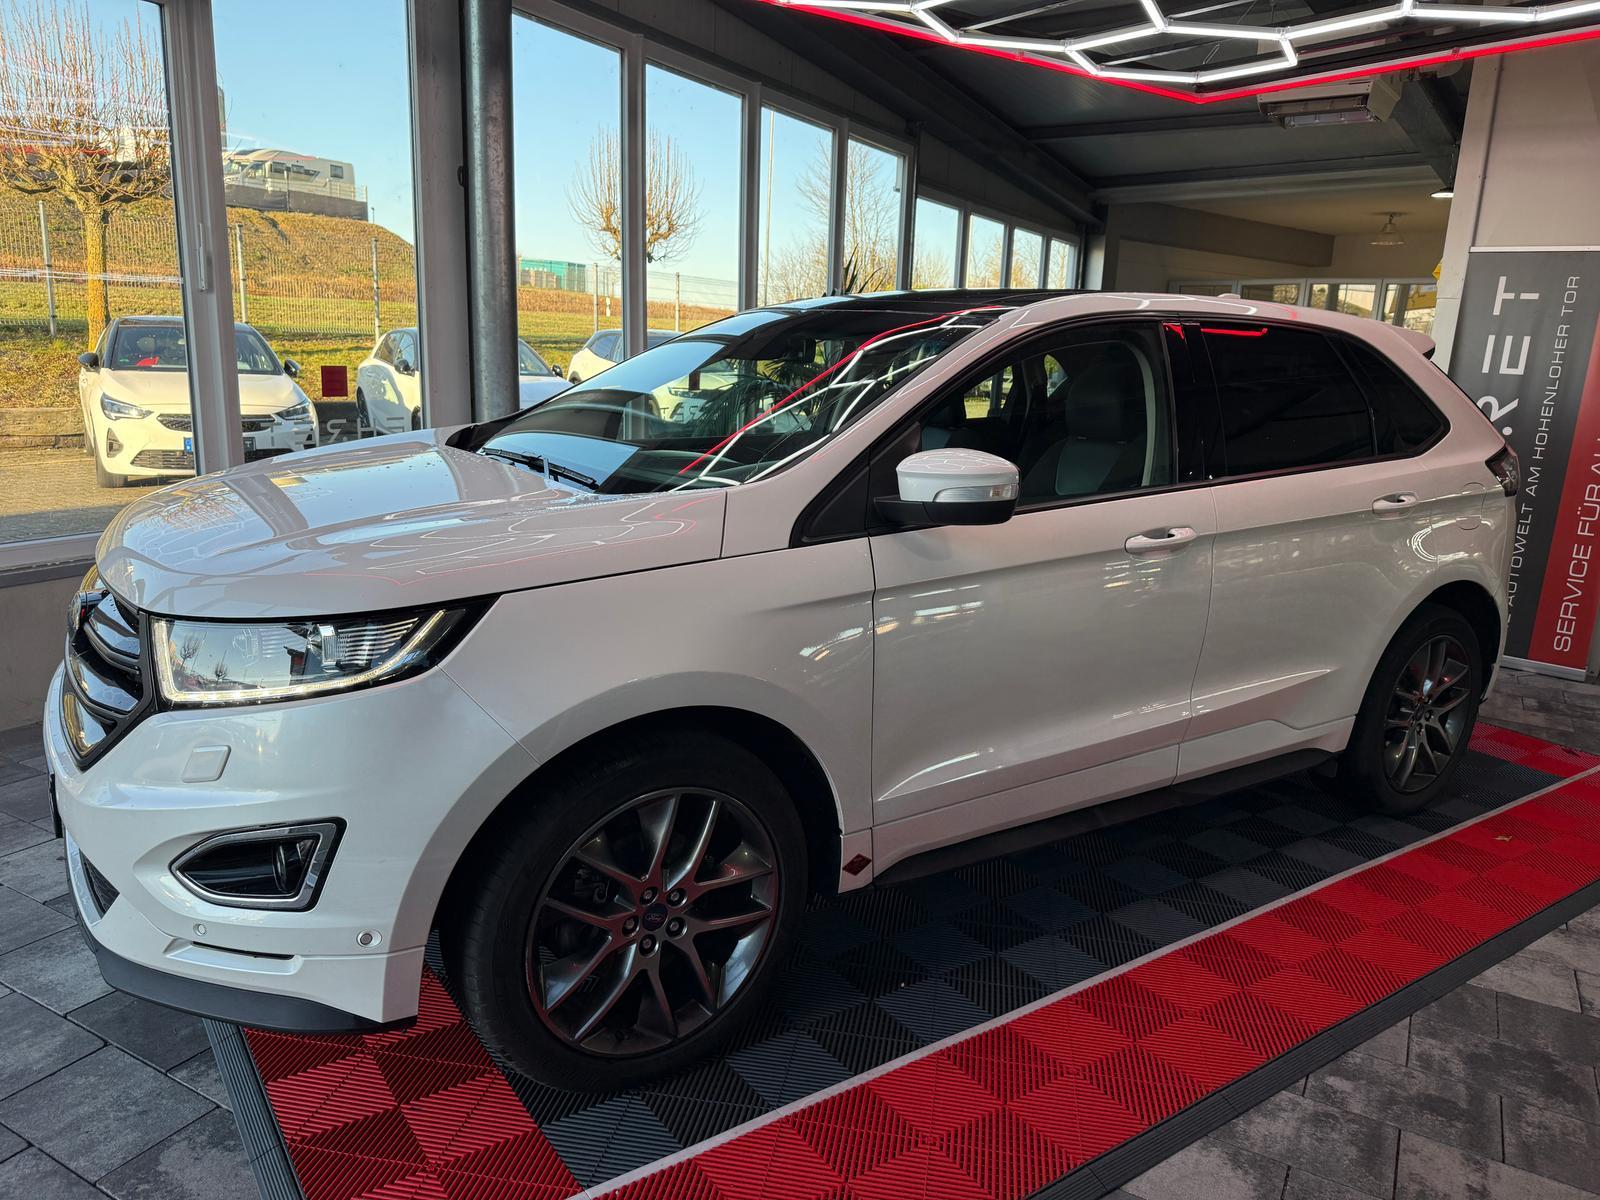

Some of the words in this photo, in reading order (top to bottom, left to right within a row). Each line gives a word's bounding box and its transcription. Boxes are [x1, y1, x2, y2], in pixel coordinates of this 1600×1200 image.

[1476, 276, 1540, 436] RET
[1561, 276, 1580, 317] TOR
[1532, 324, 1570, 460] HOHENLOHER
[1525, 466, 1542, 497] AM
[1553, 543, 1592, 652] SERVICE
[1577, 484, 1600, 537] FÜR
